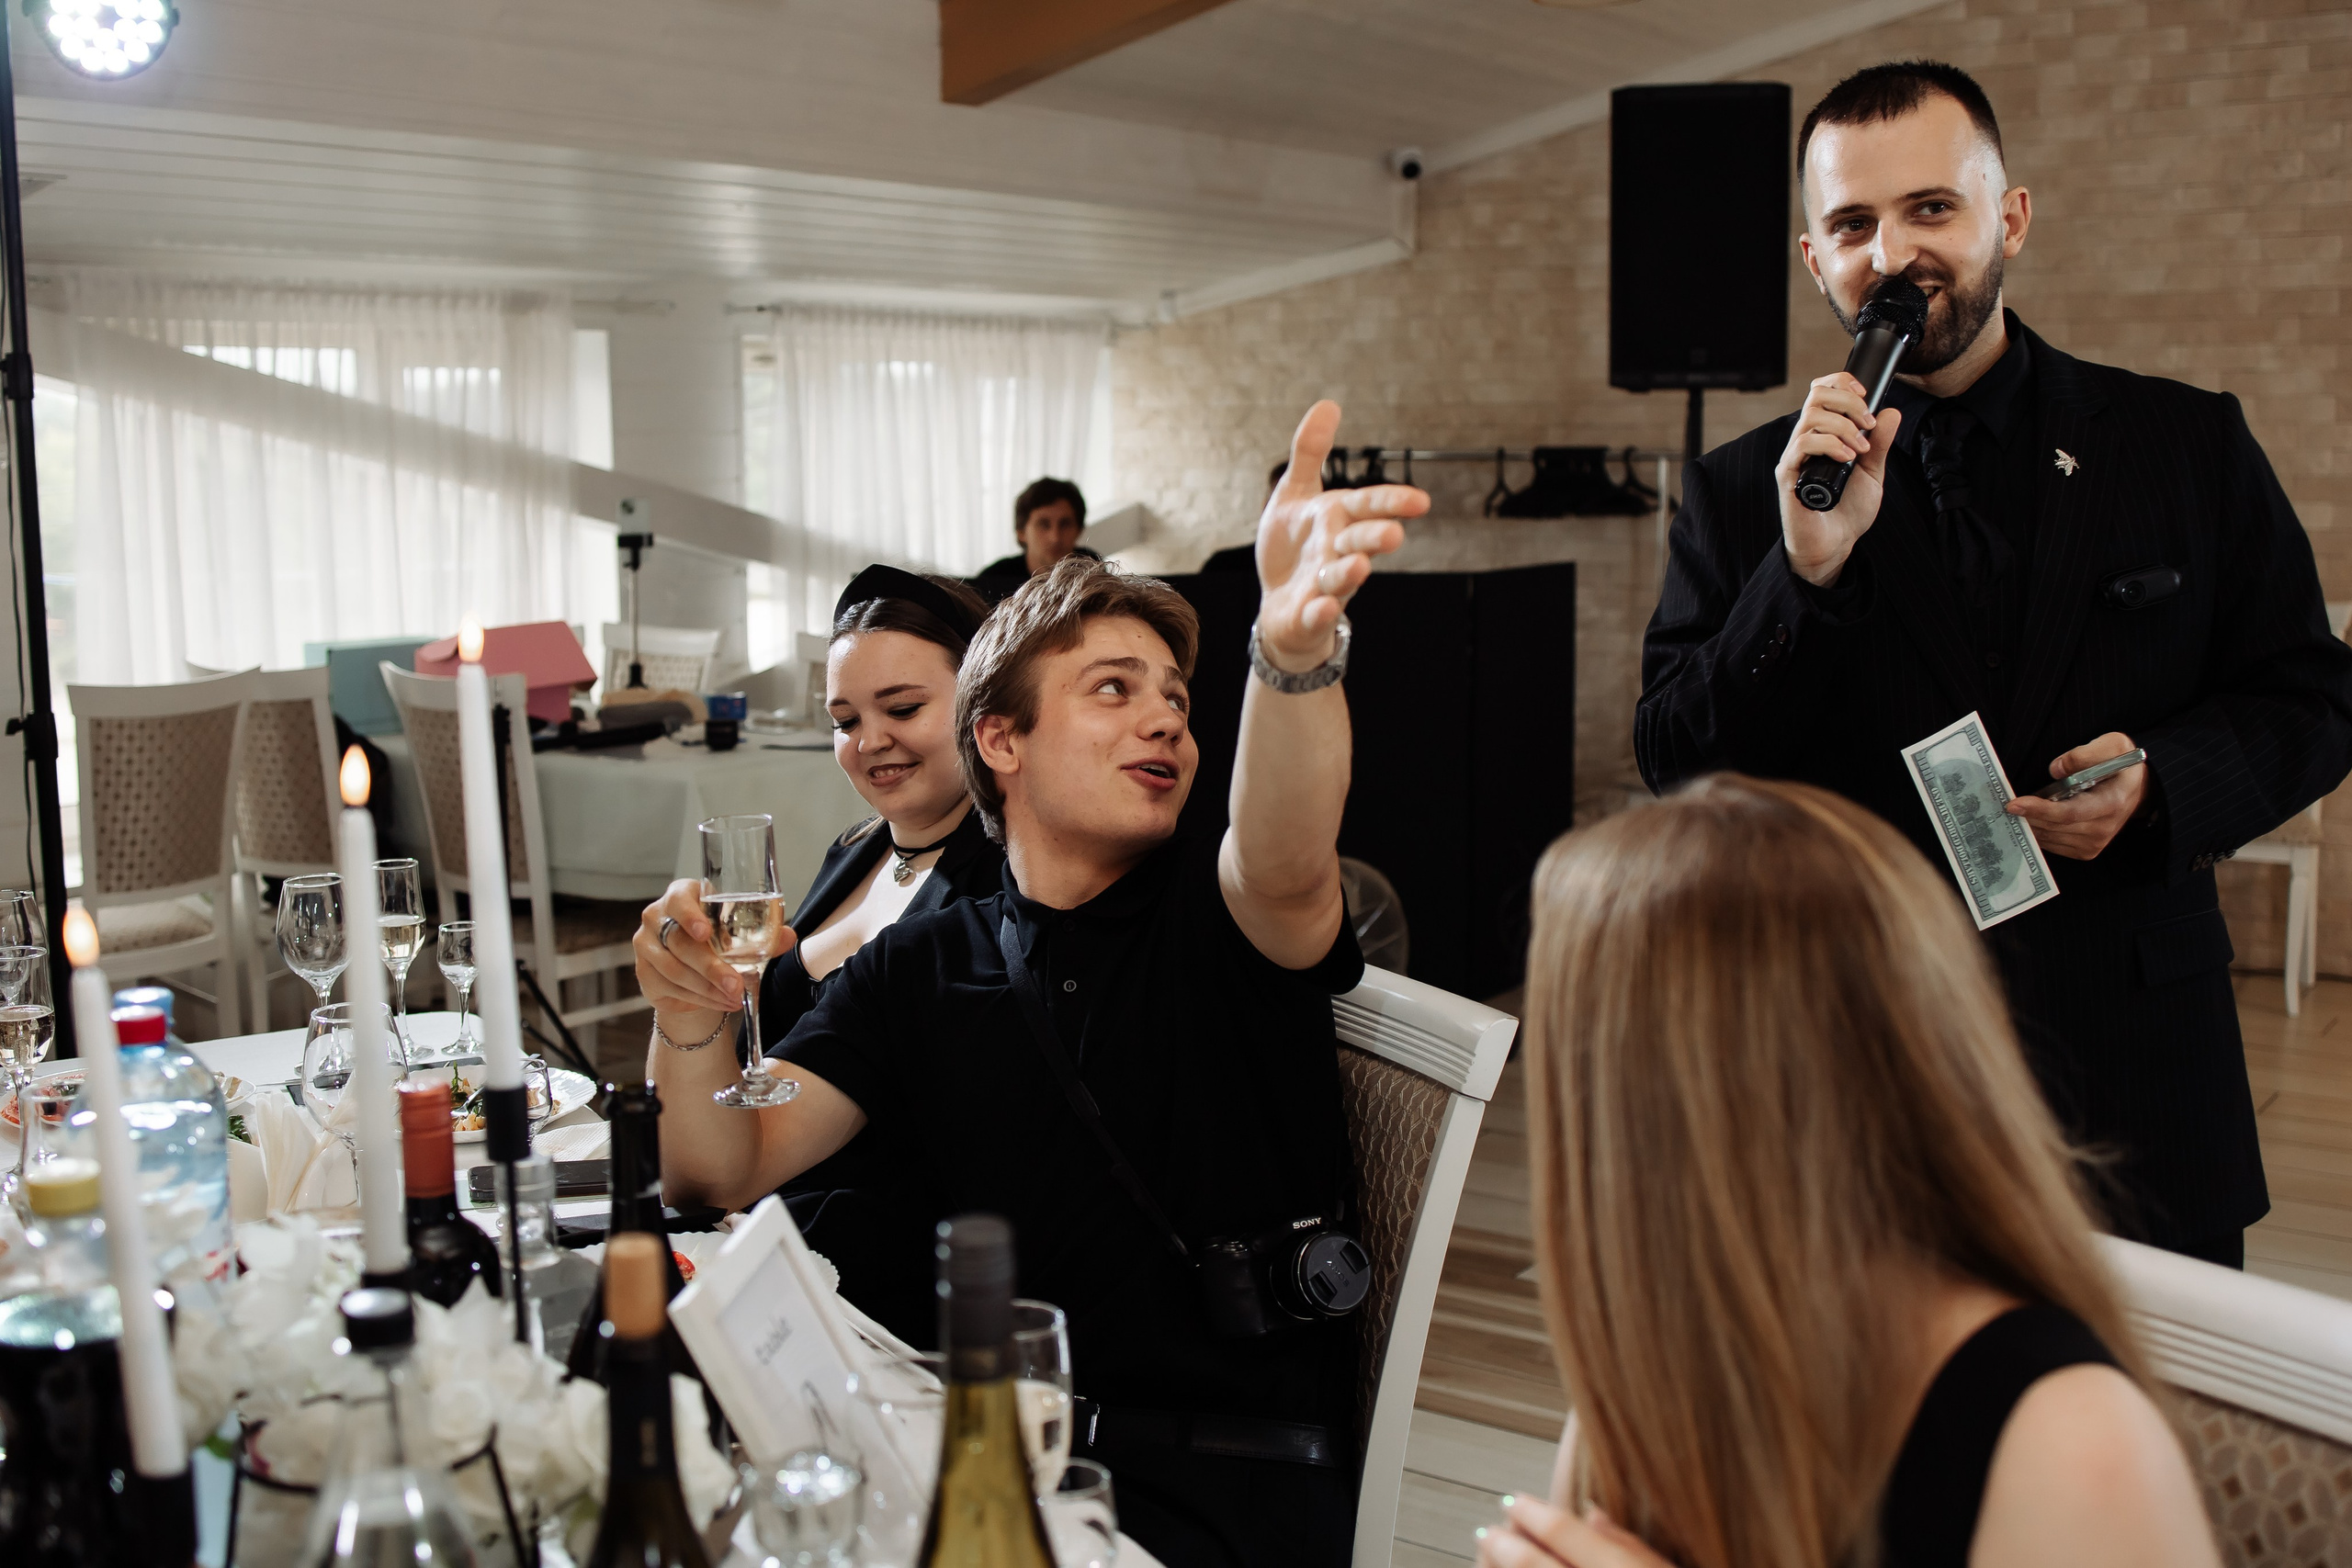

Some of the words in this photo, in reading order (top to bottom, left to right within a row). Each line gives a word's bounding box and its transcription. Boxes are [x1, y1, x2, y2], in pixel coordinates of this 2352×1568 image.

[1929, 785, 1944, 807] ONE
[1937, 802, 1962, 846] HUNDRED
[1955, 843, 1980, 886] DOLLARS
[1974, 743, 1989, 763] THE
[1983, 761, 2004, 794] UNITED
[2015, 831, 2039, 874] AMERICA
[1293, 1217, 1321, 1229] SONY
[1326, 1260, 1350, 1287] SONY
